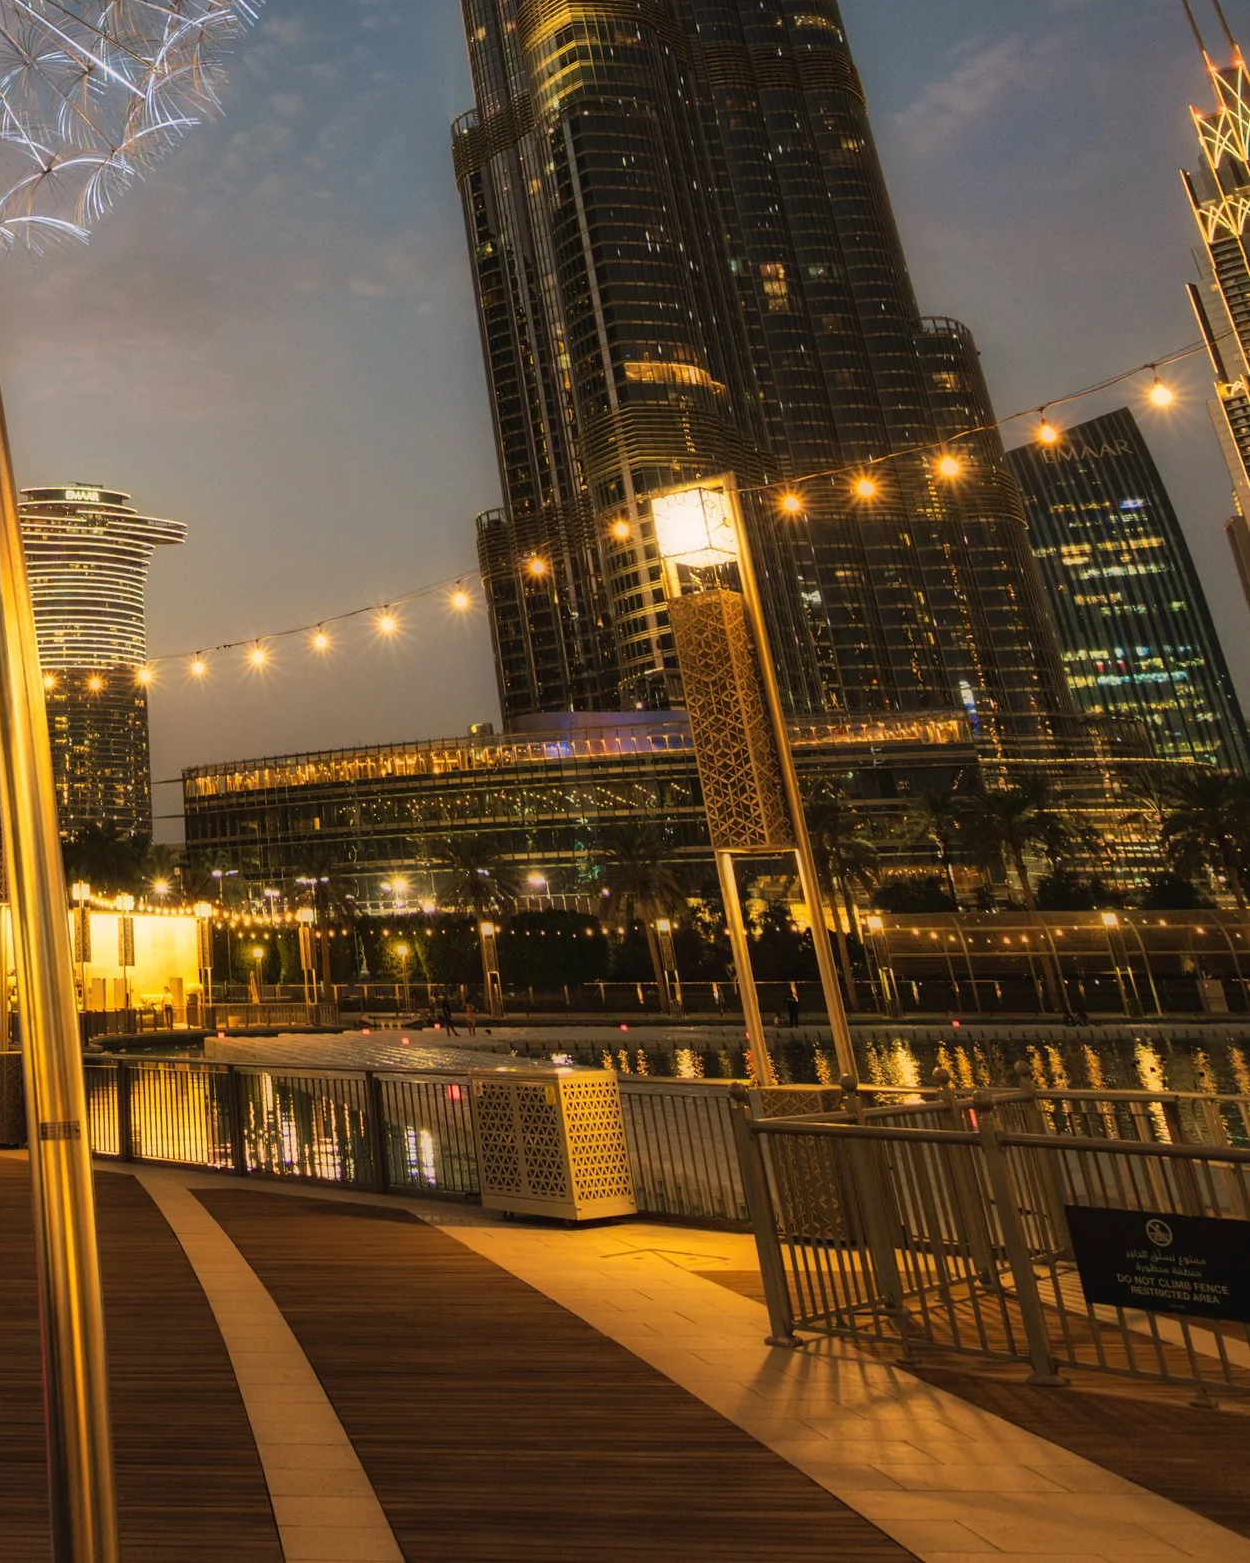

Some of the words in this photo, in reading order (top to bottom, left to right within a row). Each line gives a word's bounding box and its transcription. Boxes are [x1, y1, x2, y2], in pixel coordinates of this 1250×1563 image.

[1041, 439, 1134, 464] EMAAR
[65, 490, 100, 502] EMAAR
[1117, 1274, 1132, 1283] DO
[1134, 1276, 1155, 1286] NOT
[1158, 1279, 1191, 1289] CLIMB
[1194, 1282, 1230, 1295] FENCE
[1131, 1286, 1190, 1300] RESTRICTED
[1193, 1293, 1220, 1304] AREA
